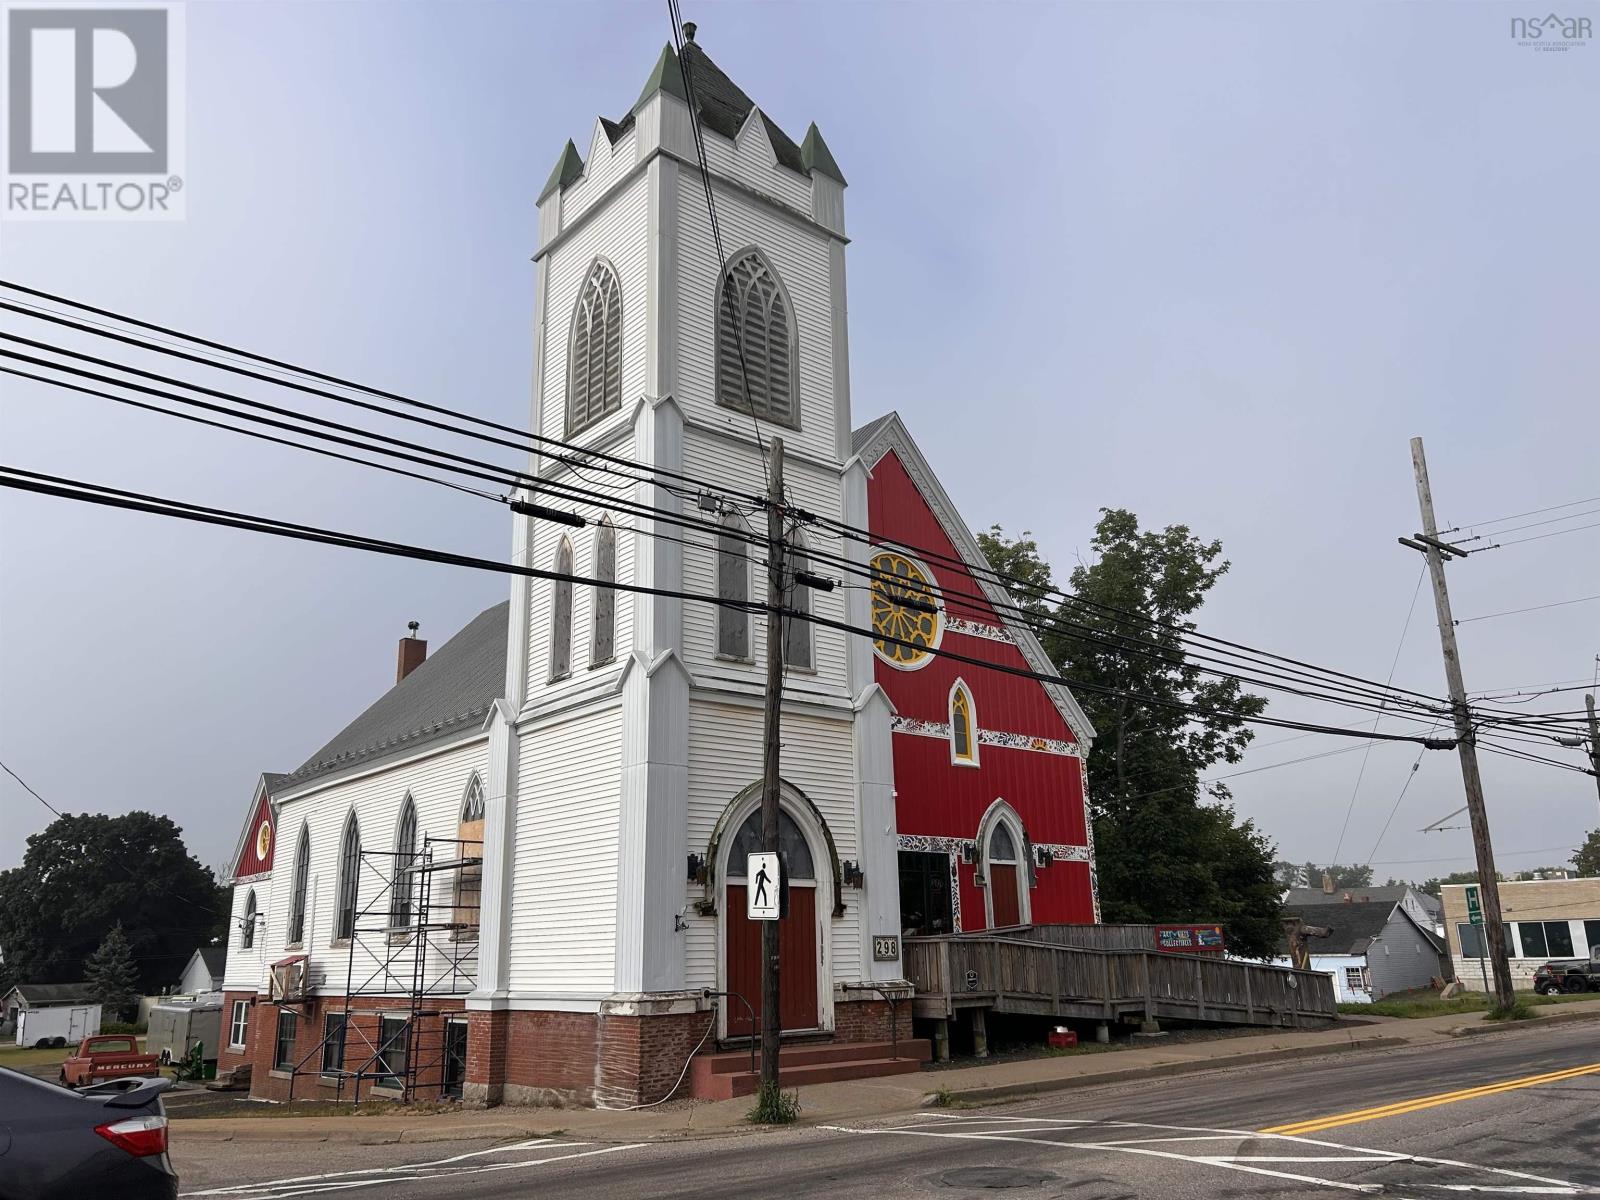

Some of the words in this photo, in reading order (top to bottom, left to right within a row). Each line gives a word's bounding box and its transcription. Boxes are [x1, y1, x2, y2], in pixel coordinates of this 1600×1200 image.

[1467, 890, 1479, 909] H
[876, 941, 896, 955] 298
[96, 1062, 152, 1071] MERCURY
